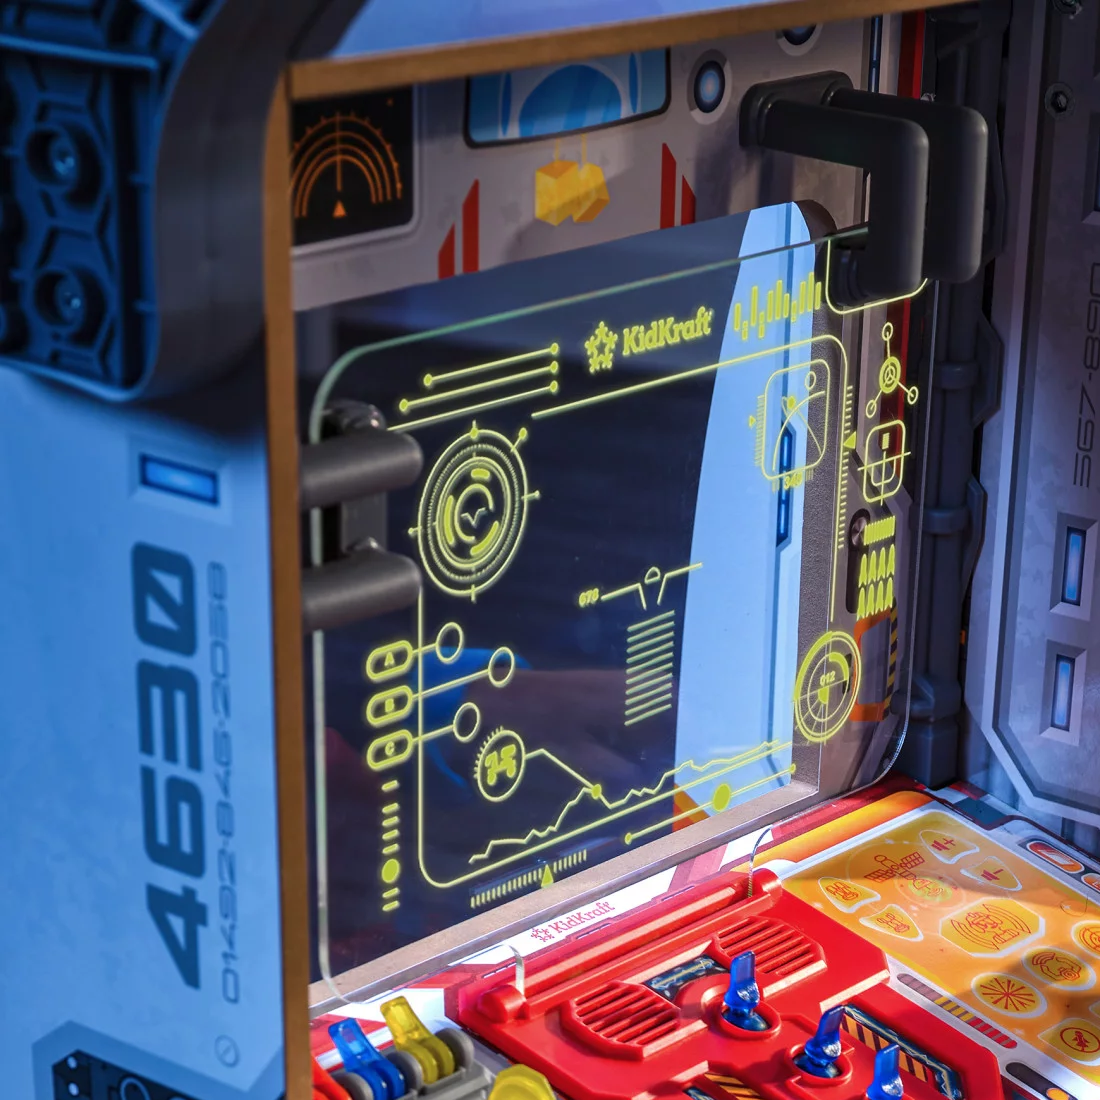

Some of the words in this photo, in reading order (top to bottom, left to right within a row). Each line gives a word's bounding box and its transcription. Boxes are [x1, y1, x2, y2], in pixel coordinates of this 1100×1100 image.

[622, 306, 712, 356] KidKraft
[384, 651, 395, 667] A
[131, 541, 208, 990] 4630
[547, 901, 616, 934] KidKraft
